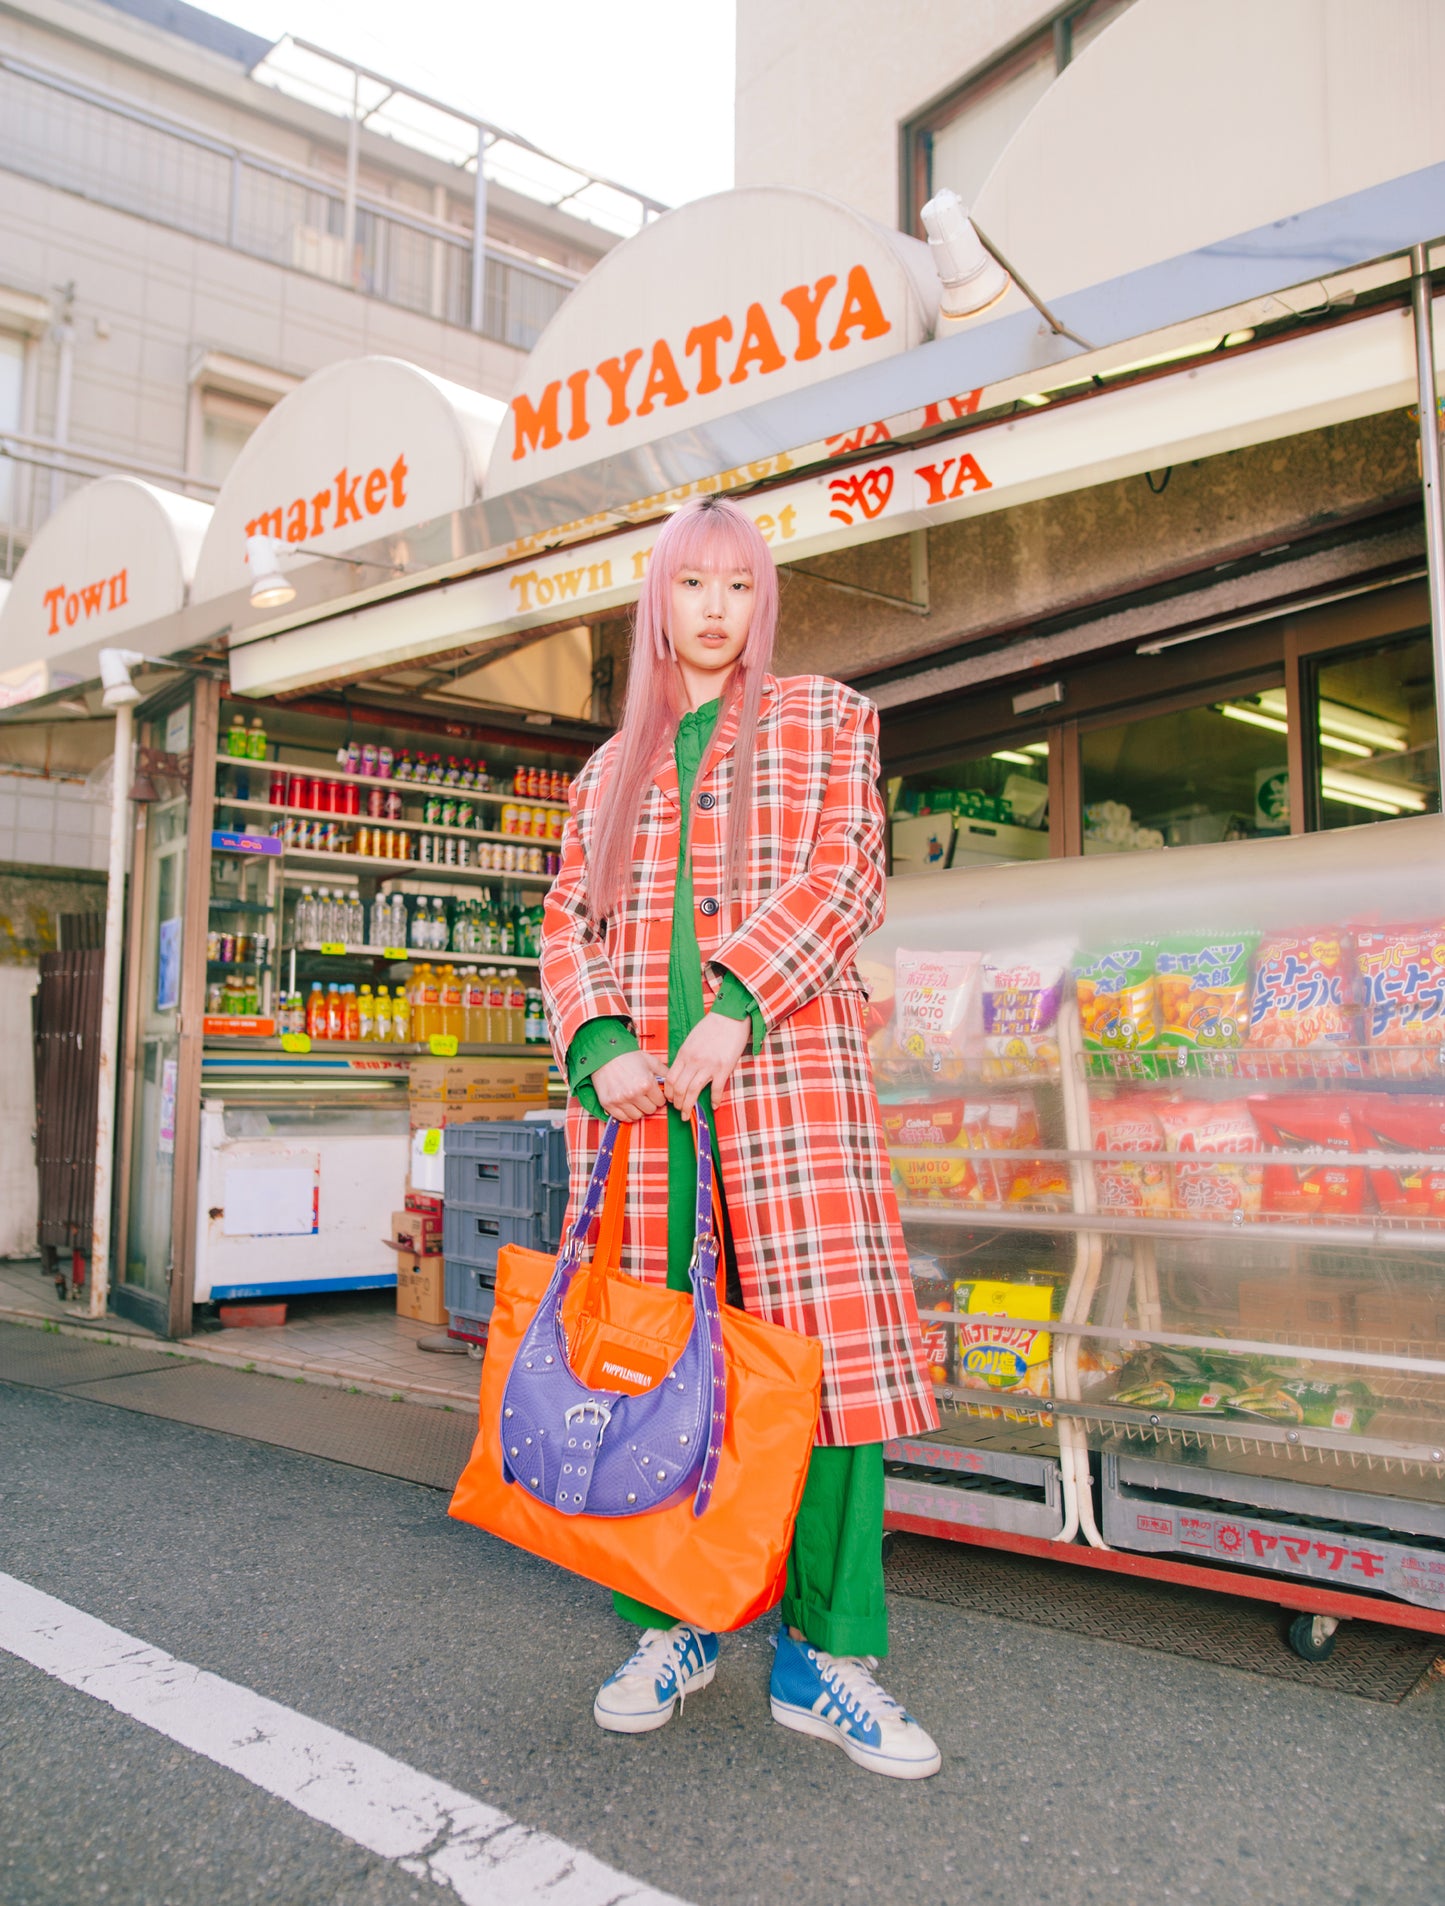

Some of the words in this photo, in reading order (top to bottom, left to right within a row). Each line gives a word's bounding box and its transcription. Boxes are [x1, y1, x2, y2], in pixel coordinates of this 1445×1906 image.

[511, 264, 891, 461] MIYATAYA
[914, 453, 993, 505] YA
[42, 567, 129, 636] Town
[509, 559, 613, 613] Town
[1156, 943, 1244, 973] キャベツ
[1189, 967, 1230, 991] 太郎
[1251, 972, 1342, 1024] チップル
[1371, 979, 1445, 1036] チップ
[967, 1350, 1017, 1375] のり塩
